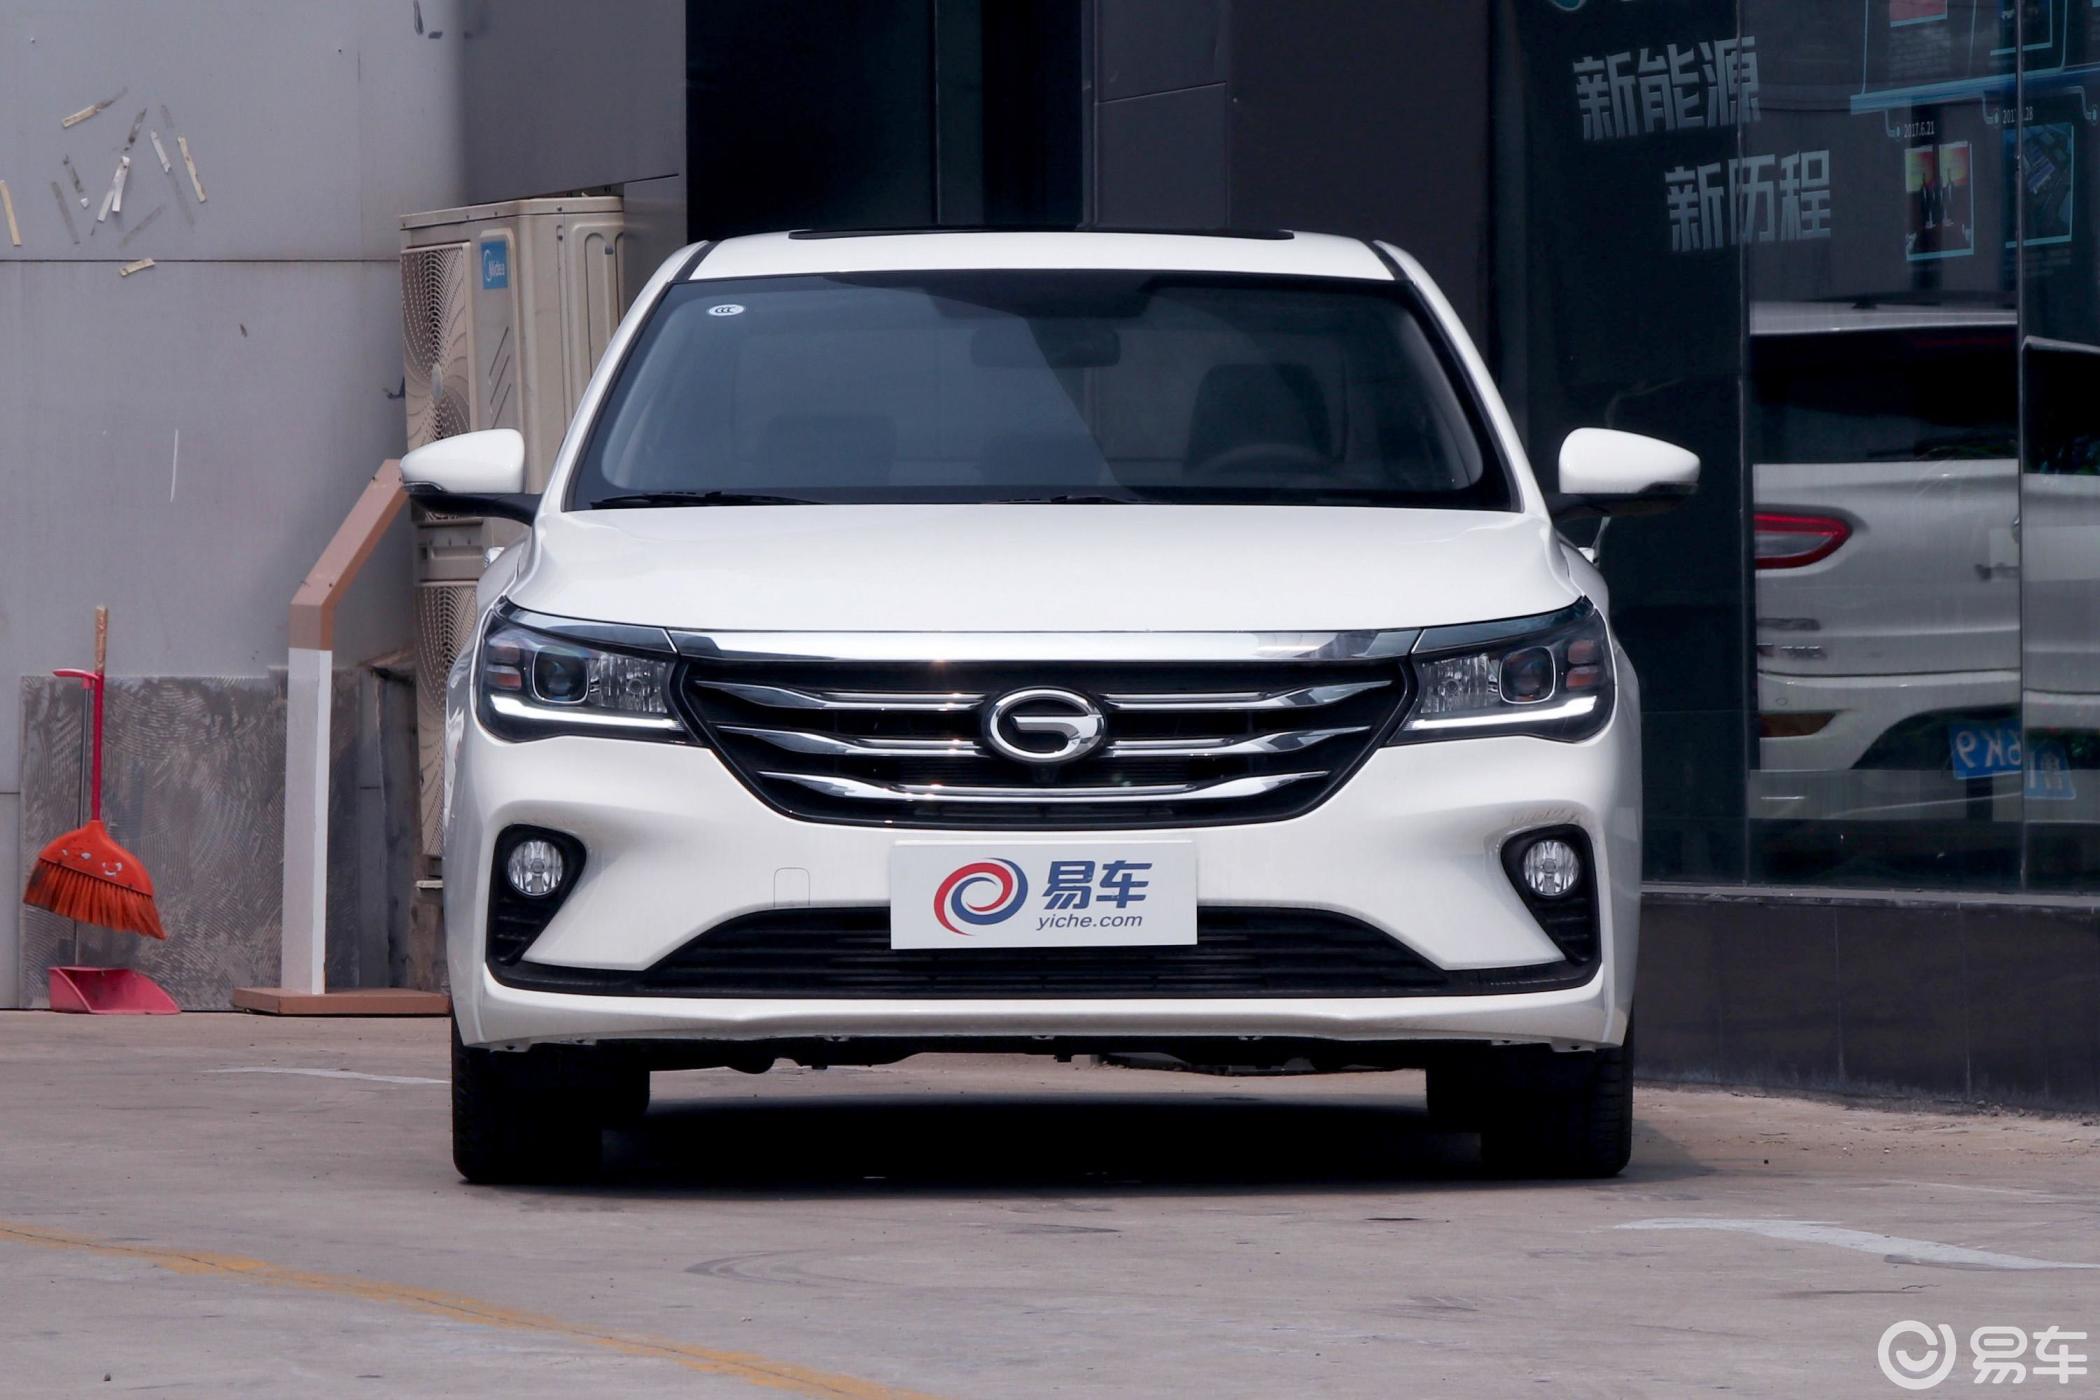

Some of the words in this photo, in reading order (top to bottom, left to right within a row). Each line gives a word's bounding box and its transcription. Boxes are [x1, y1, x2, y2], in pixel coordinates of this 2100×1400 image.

[1573, 36, 1761, 140] 新能源
[1903, 120, 1935, 138] 2017.6.21
[1664, 150, 1831, 252] 新历程
[1042, 860, 1152, 910] 易车
[1036, 913, 1143, 931] yiche.com
